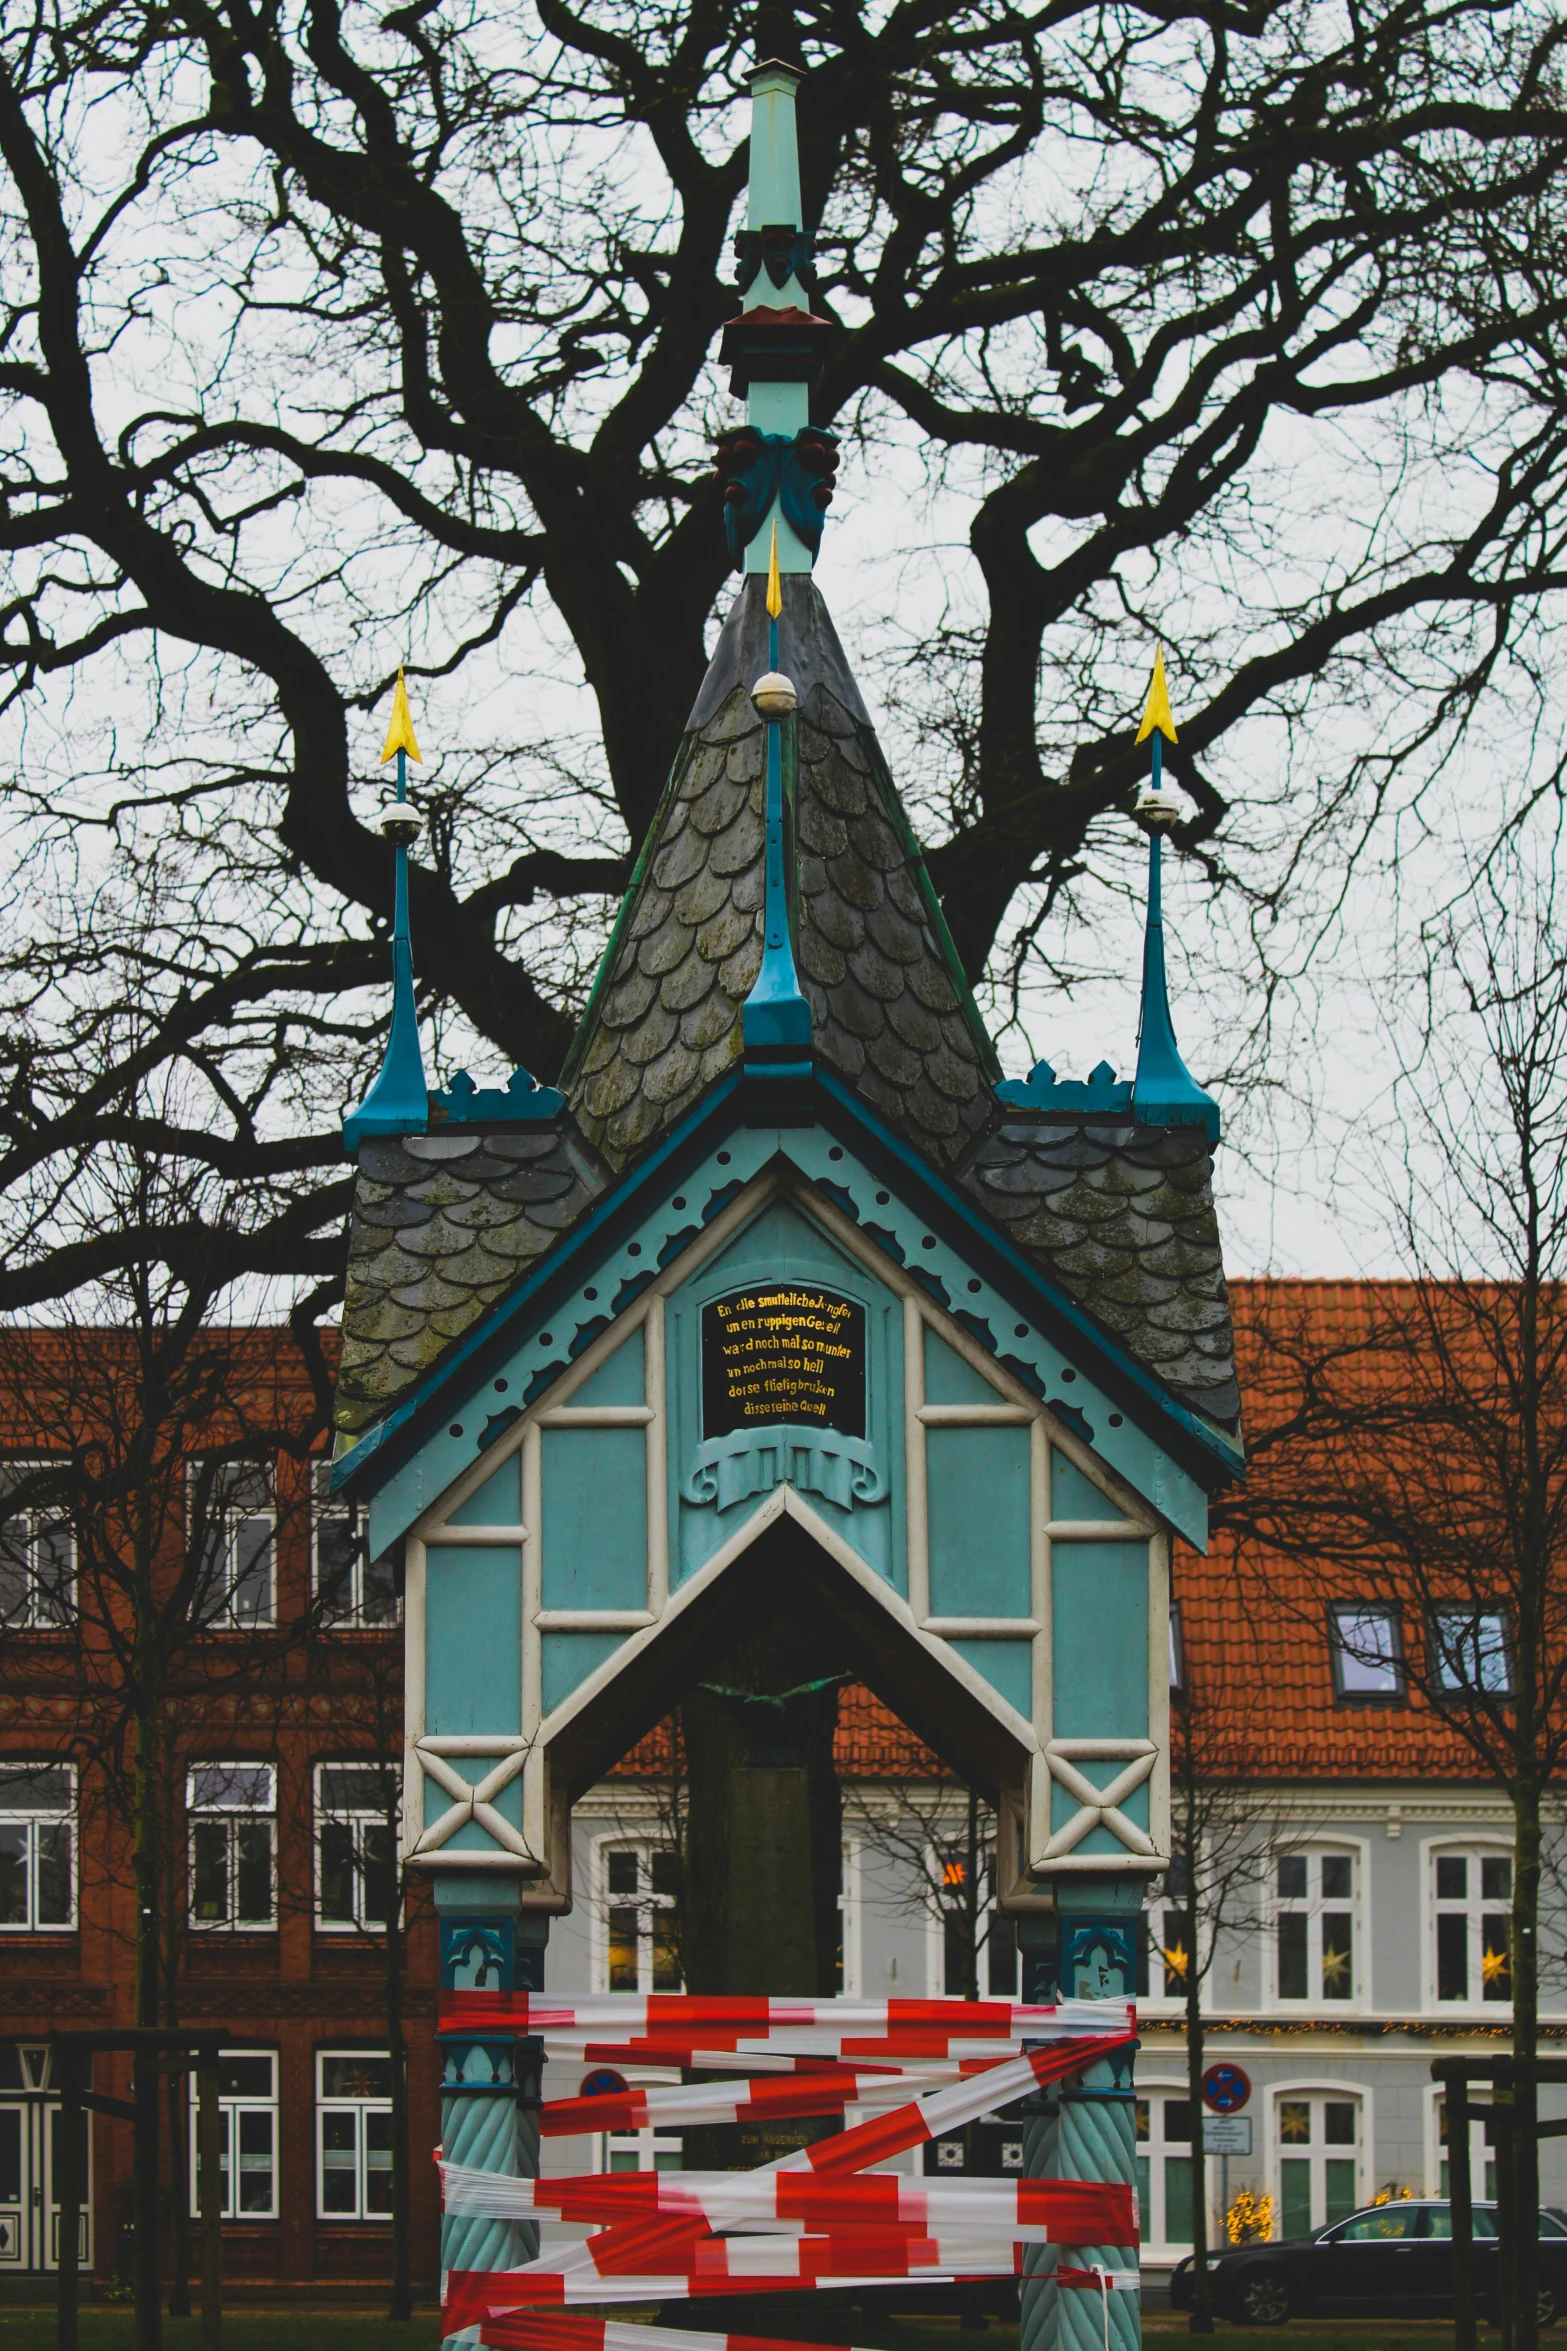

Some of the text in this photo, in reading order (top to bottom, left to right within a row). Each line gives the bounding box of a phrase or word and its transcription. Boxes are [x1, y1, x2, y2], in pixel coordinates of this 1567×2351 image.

[717, 1305, 732, 1317] En
[741, 1319, 755, 1330] en
[758, 1314, 806, 1331] ruppigen
[723, 1334, 851, 1358] ward noch mal so munter
[728, 1356, 824, 1377] un noch mal so hell
[798, 1380, 835, 1397] bruken
[744, 1402, 770, 1415] disse
[800, 1400, 826, 1415] Quell
[741, 2135, 759, 2145] ZUM
